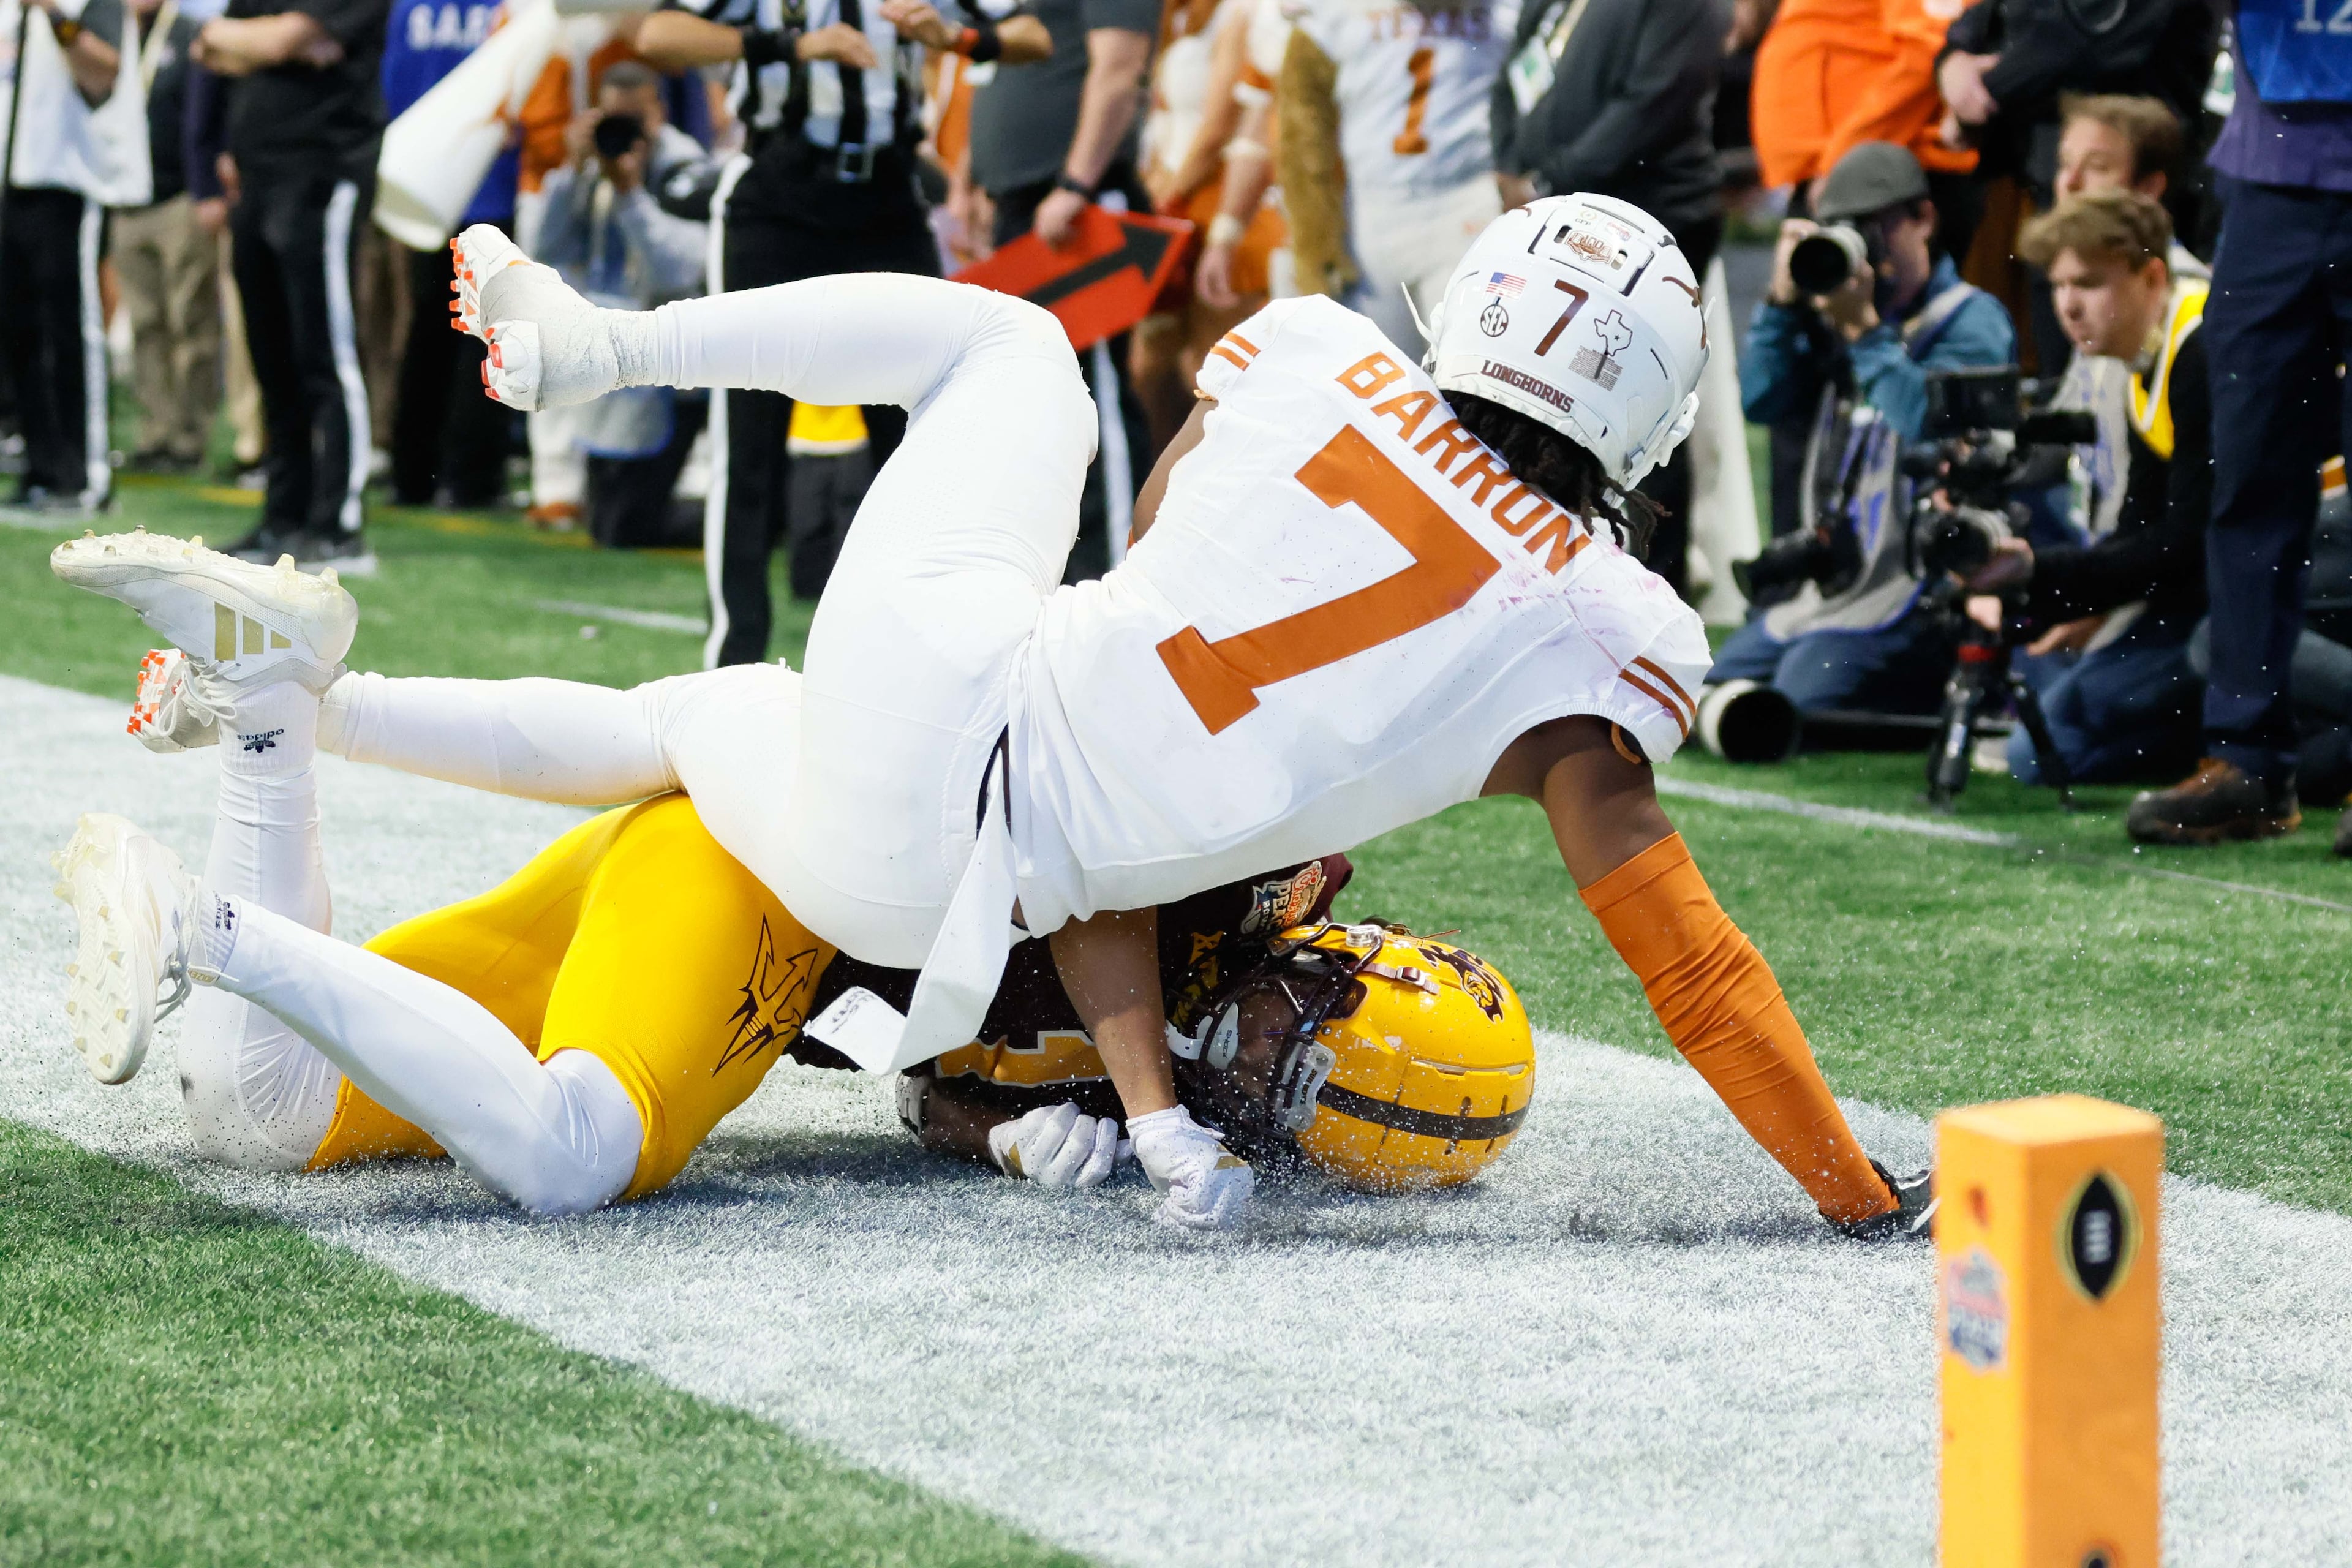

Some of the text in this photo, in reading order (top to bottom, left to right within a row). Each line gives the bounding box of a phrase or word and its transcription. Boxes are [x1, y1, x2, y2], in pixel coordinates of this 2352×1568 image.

[1392, 48, 1434, 156] 1
[1482, 306, 1508, 336] SEC
[1534, 279, 1589, 356] 7
[1480, 360, 1574, 413] LONGHORNS
[1335, 352, 1592, 576] BARRON
[1156, 423, 1502, 735] 7
